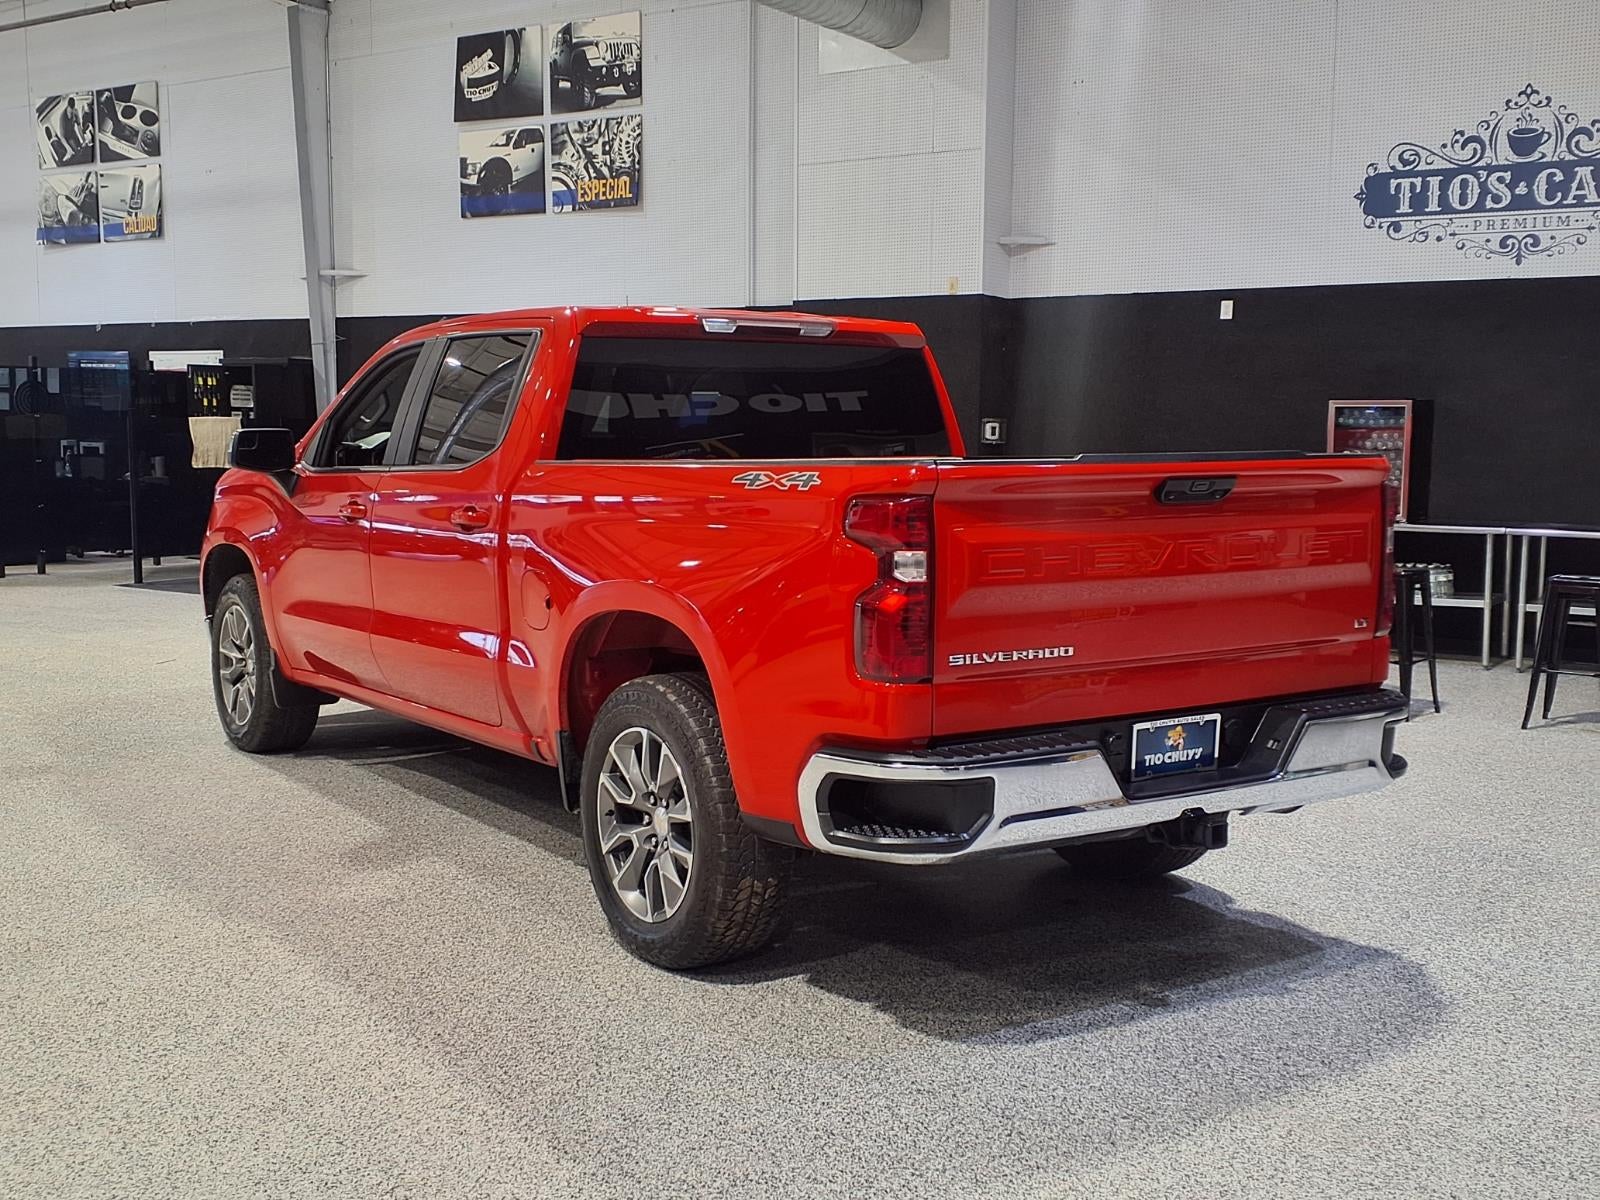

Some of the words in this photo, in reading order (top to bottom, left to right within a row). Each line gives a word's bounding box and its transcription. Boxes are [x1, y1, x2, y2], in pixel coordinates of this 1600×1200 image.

[578, 176, 632, 202] ESPECIAL
[1390, 170, 1512, 213] TIO'S
[1533, 165, 1600, 206] CA
[123, 215, 157, 234] CALIDAD
[1473, 215, 1571, 231] PREMIUM
[981, 529, 1364, 580] CHEVROLET
[949, 646, 1074, 666] SILVERADO
